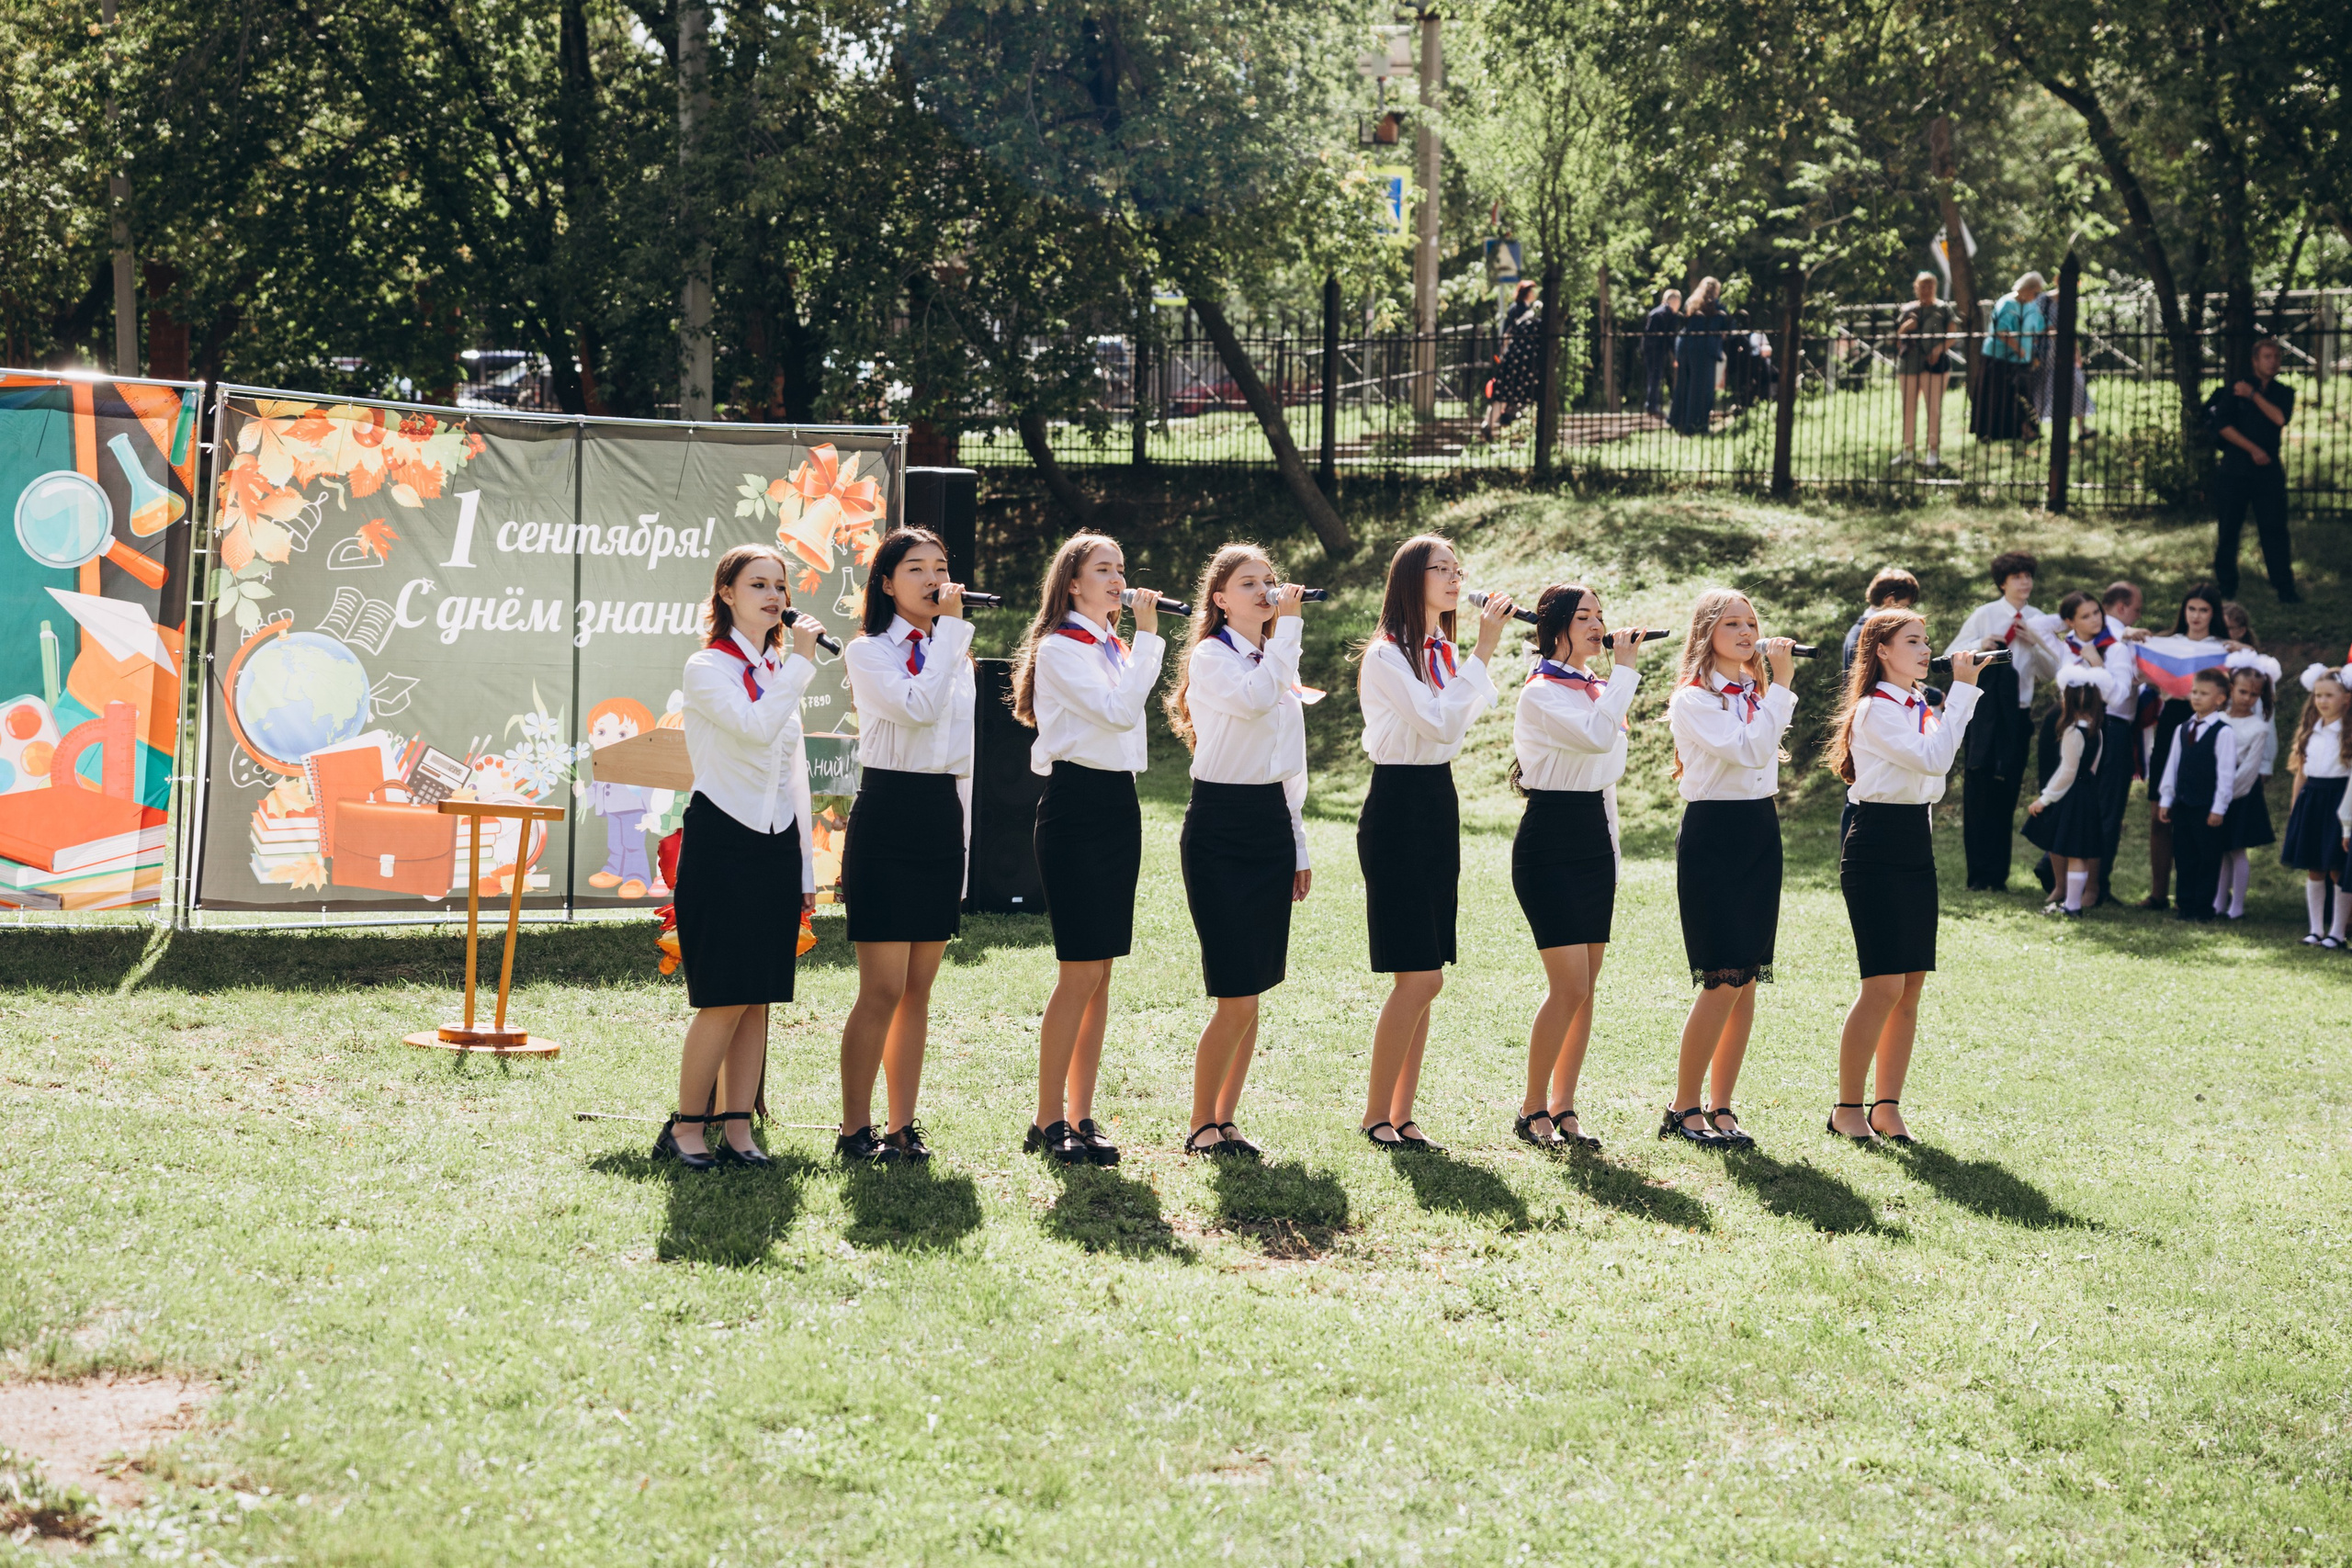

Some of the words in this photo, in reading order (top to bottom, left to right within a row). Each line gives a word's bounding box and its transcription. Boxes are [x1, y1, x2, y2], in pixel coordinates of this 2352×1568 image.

[439, 489, 481, 569] 1
[496, 512, 716, 570] сентября!
[395, 579, 430, 629] С
[436, 587, 563, 645] днём
[573, 600, 709, 648] знани
